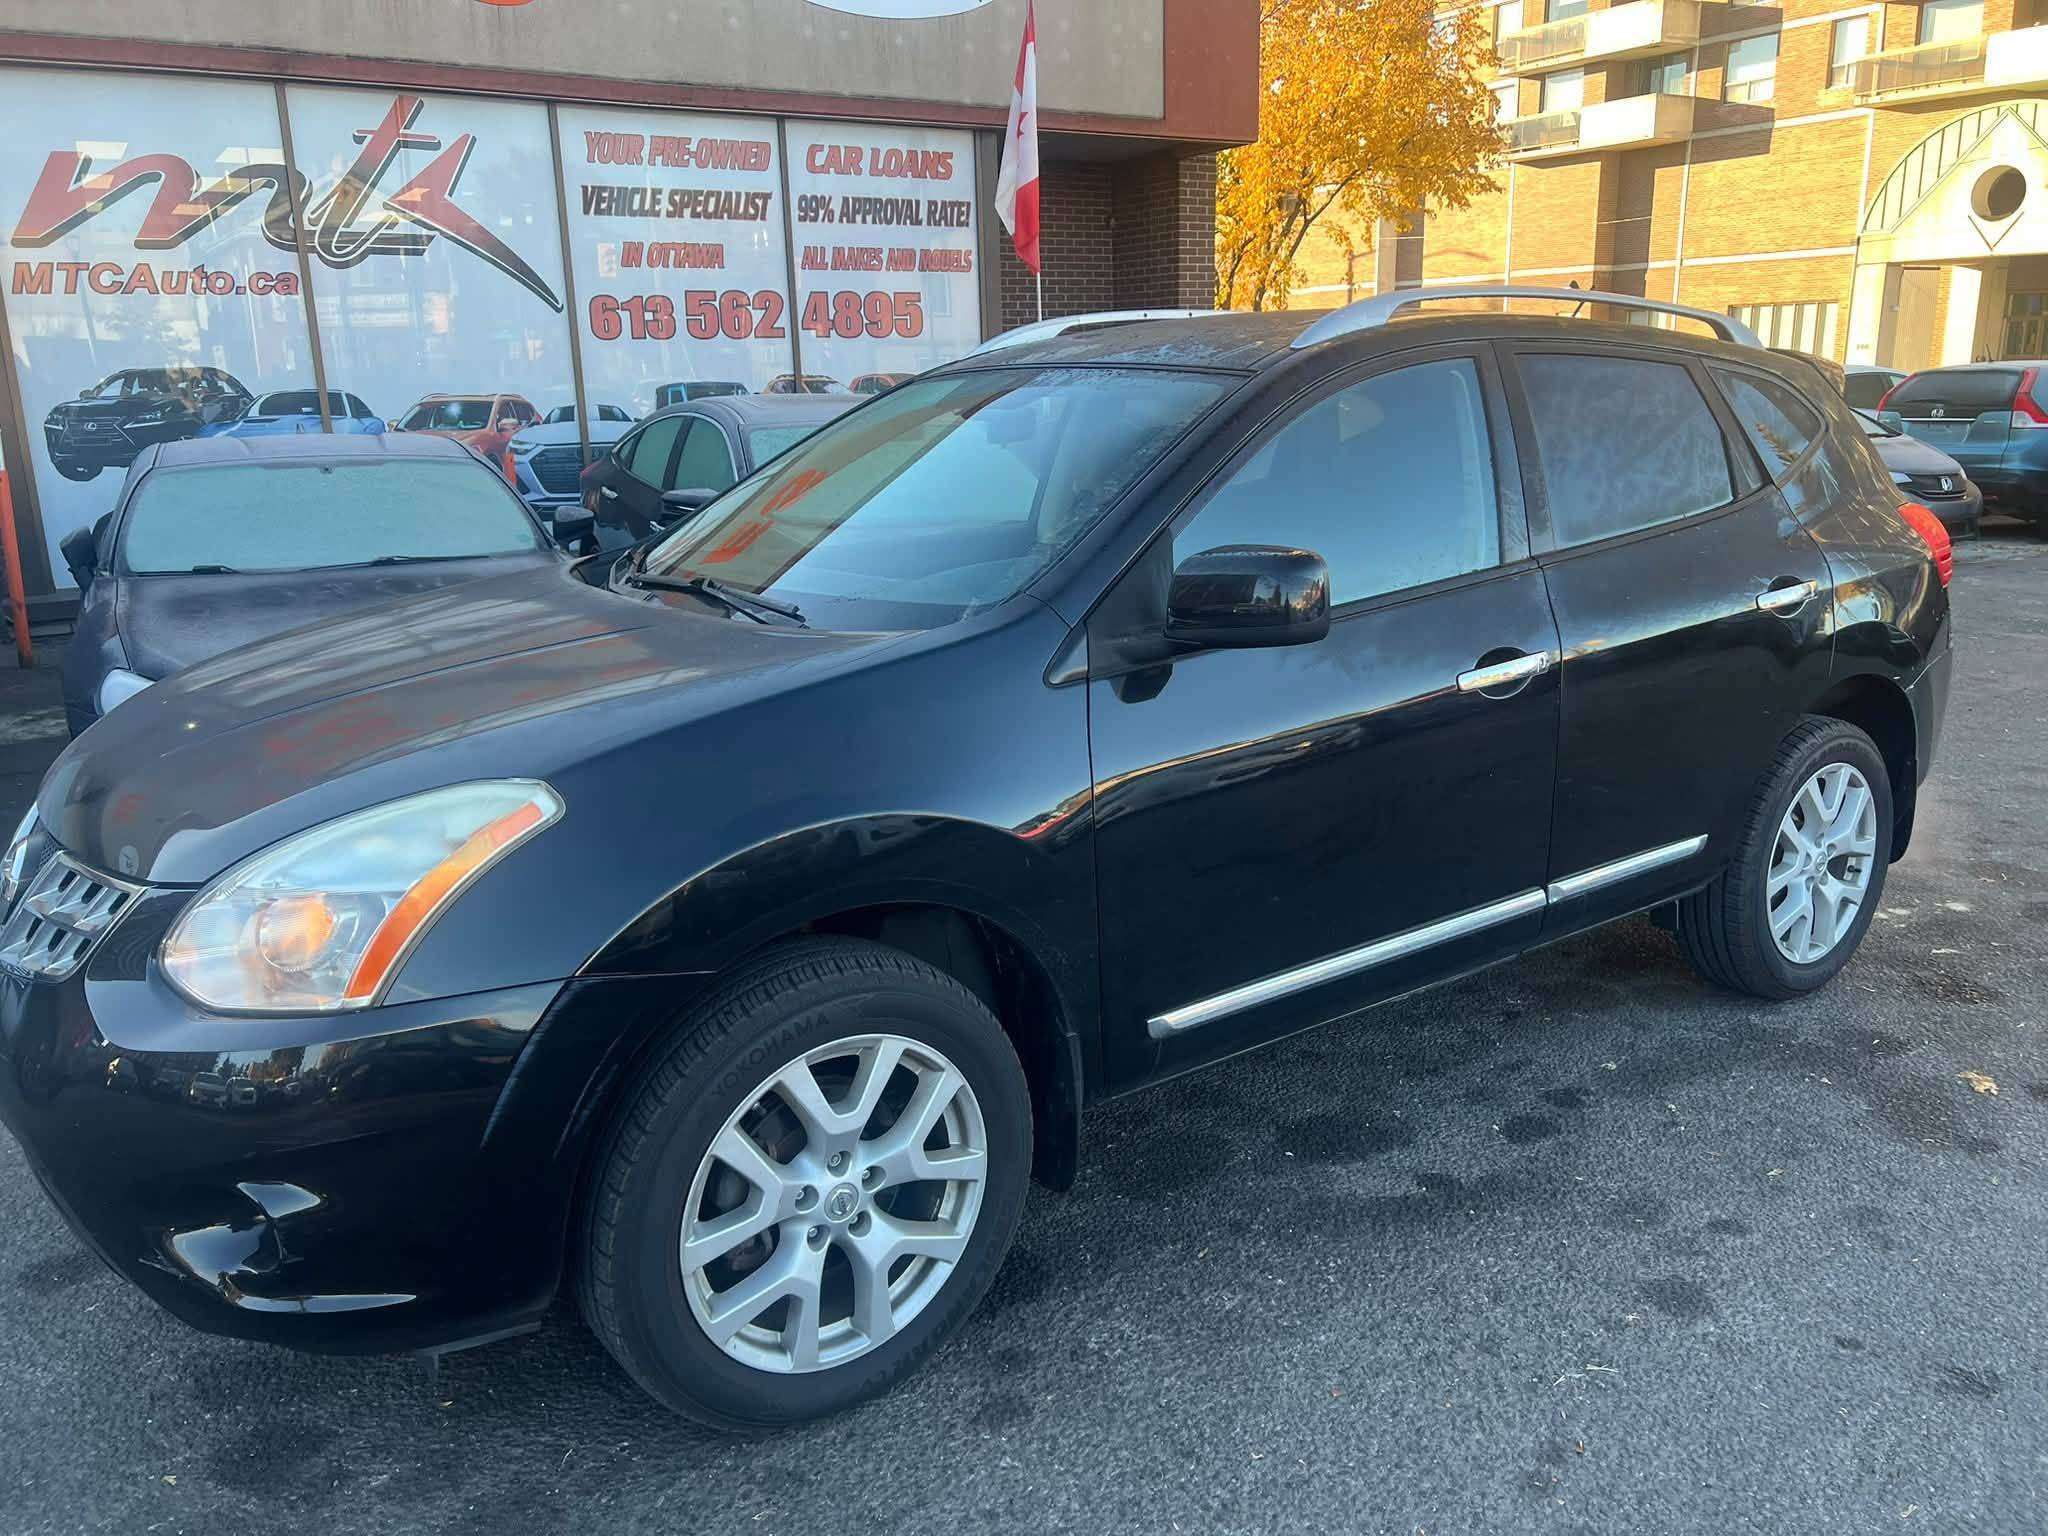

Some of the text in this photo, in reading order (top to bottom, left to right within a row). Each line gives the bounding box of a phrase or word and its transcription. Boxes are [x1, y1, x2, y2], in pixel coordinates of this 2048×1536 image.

[584, 131, 772, 172] YOUR PRE-OWNED
[805, 143, 954, 181] CAR LOANS
[581, 185, 773, 221] VEHICLE SPECIALIST
[797, 194, 971, 228] 99% APPROVAL RATE!
[621, 241, 725, 269] IN OTTAWA
[801, 245, 973, 273] ALL MAKES AND MODELS
[11, 261, 299, 297] MTCAuto.ca
[589, 289, 924, 340] 613 562 4895
[712, 1013, 830, 1097] YOKOHAMA
